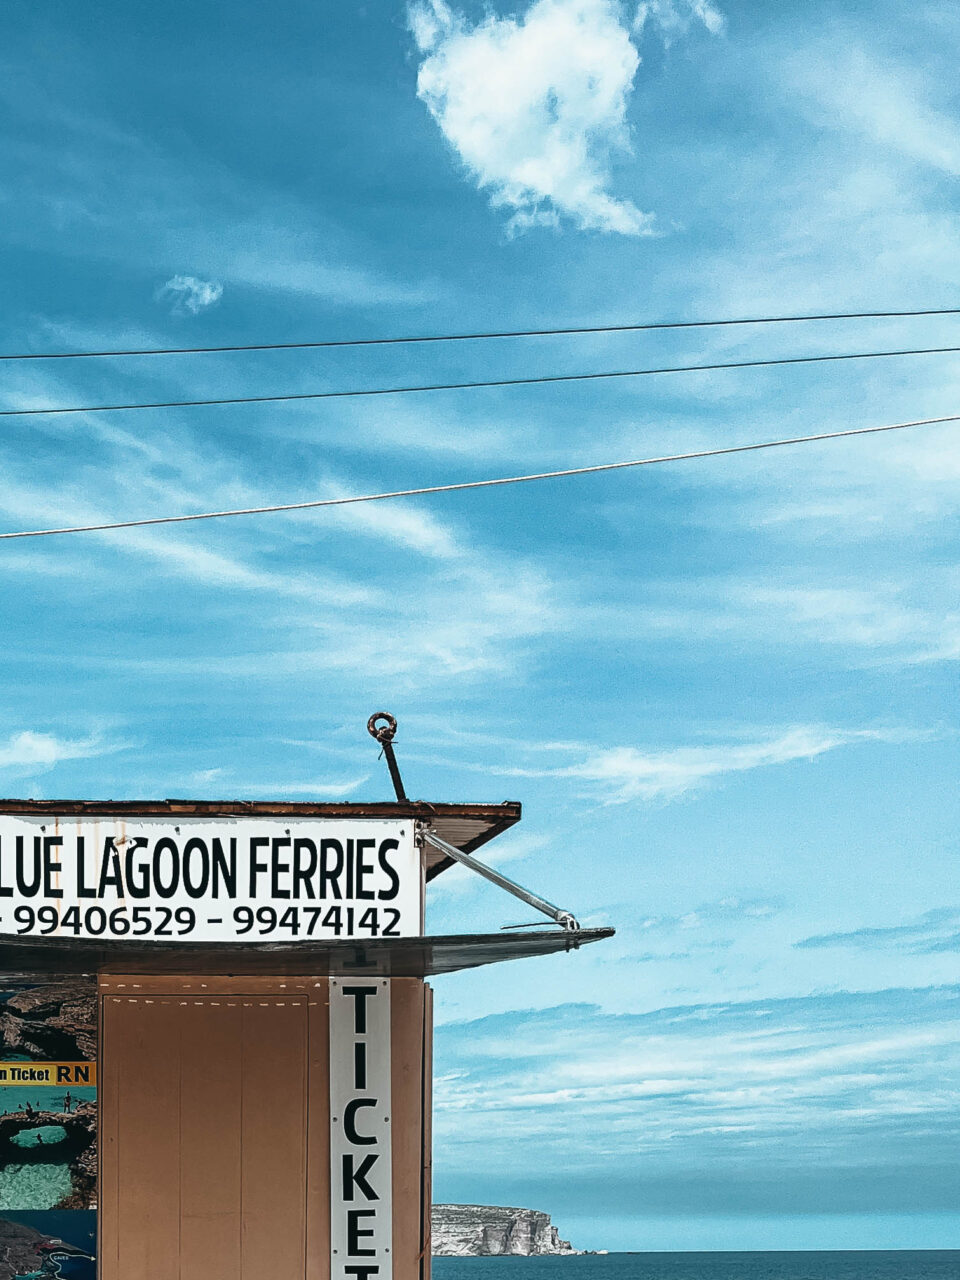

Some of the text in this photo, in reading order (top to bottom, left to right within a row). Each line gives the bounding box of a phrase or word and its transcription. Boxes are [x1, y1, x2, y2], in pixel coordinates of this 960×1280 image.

[77, 836, 237, 899] LAGOON
[249, 836, 400, 900] FERRIES
[13, 905, 196, 935] 99406529
[233, 905, 401, 936] 99474142
[10, 1068, 49, 1081] Ticket
[57, 1066, 90, 1082] RN
